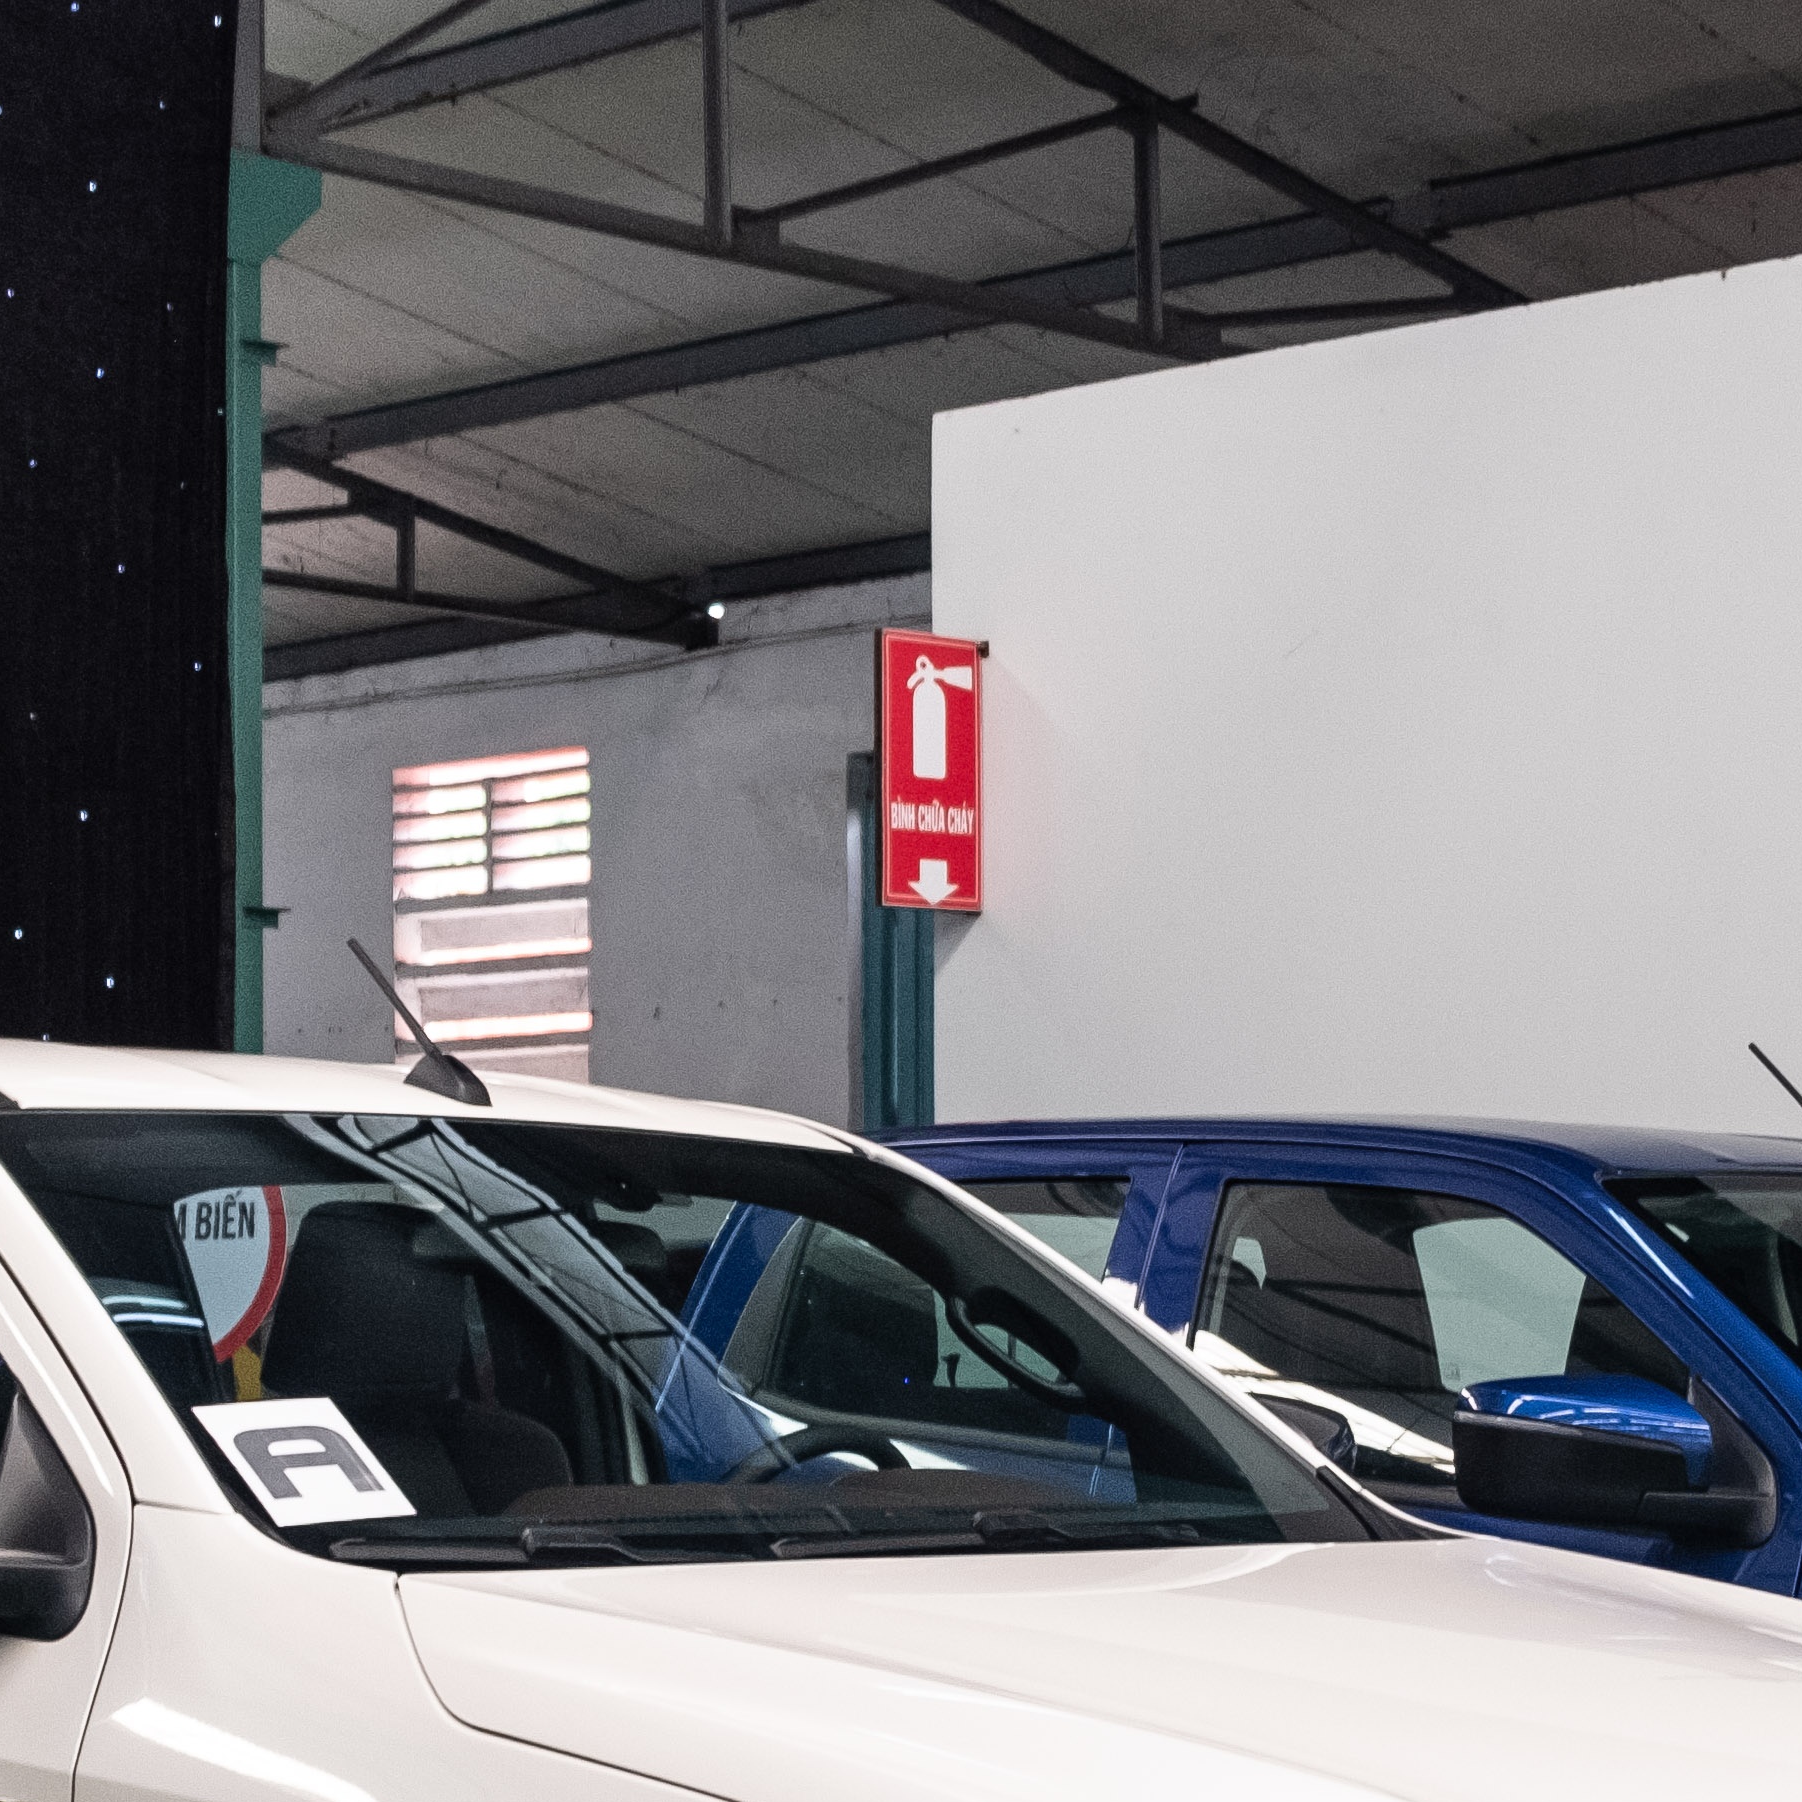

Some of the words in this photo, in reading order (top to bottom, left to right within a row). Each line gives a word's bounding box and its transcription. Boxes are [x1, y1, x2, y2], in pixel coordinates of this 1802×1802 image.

[891, 795, 915, 830] BÌNH
[918, 798, 945, 833] CHỮA
[948, 800, 974, 835] CHÁY
[195, 1189, 255, 1240] BIẾN
[233, 1426, 385, 1499] A
